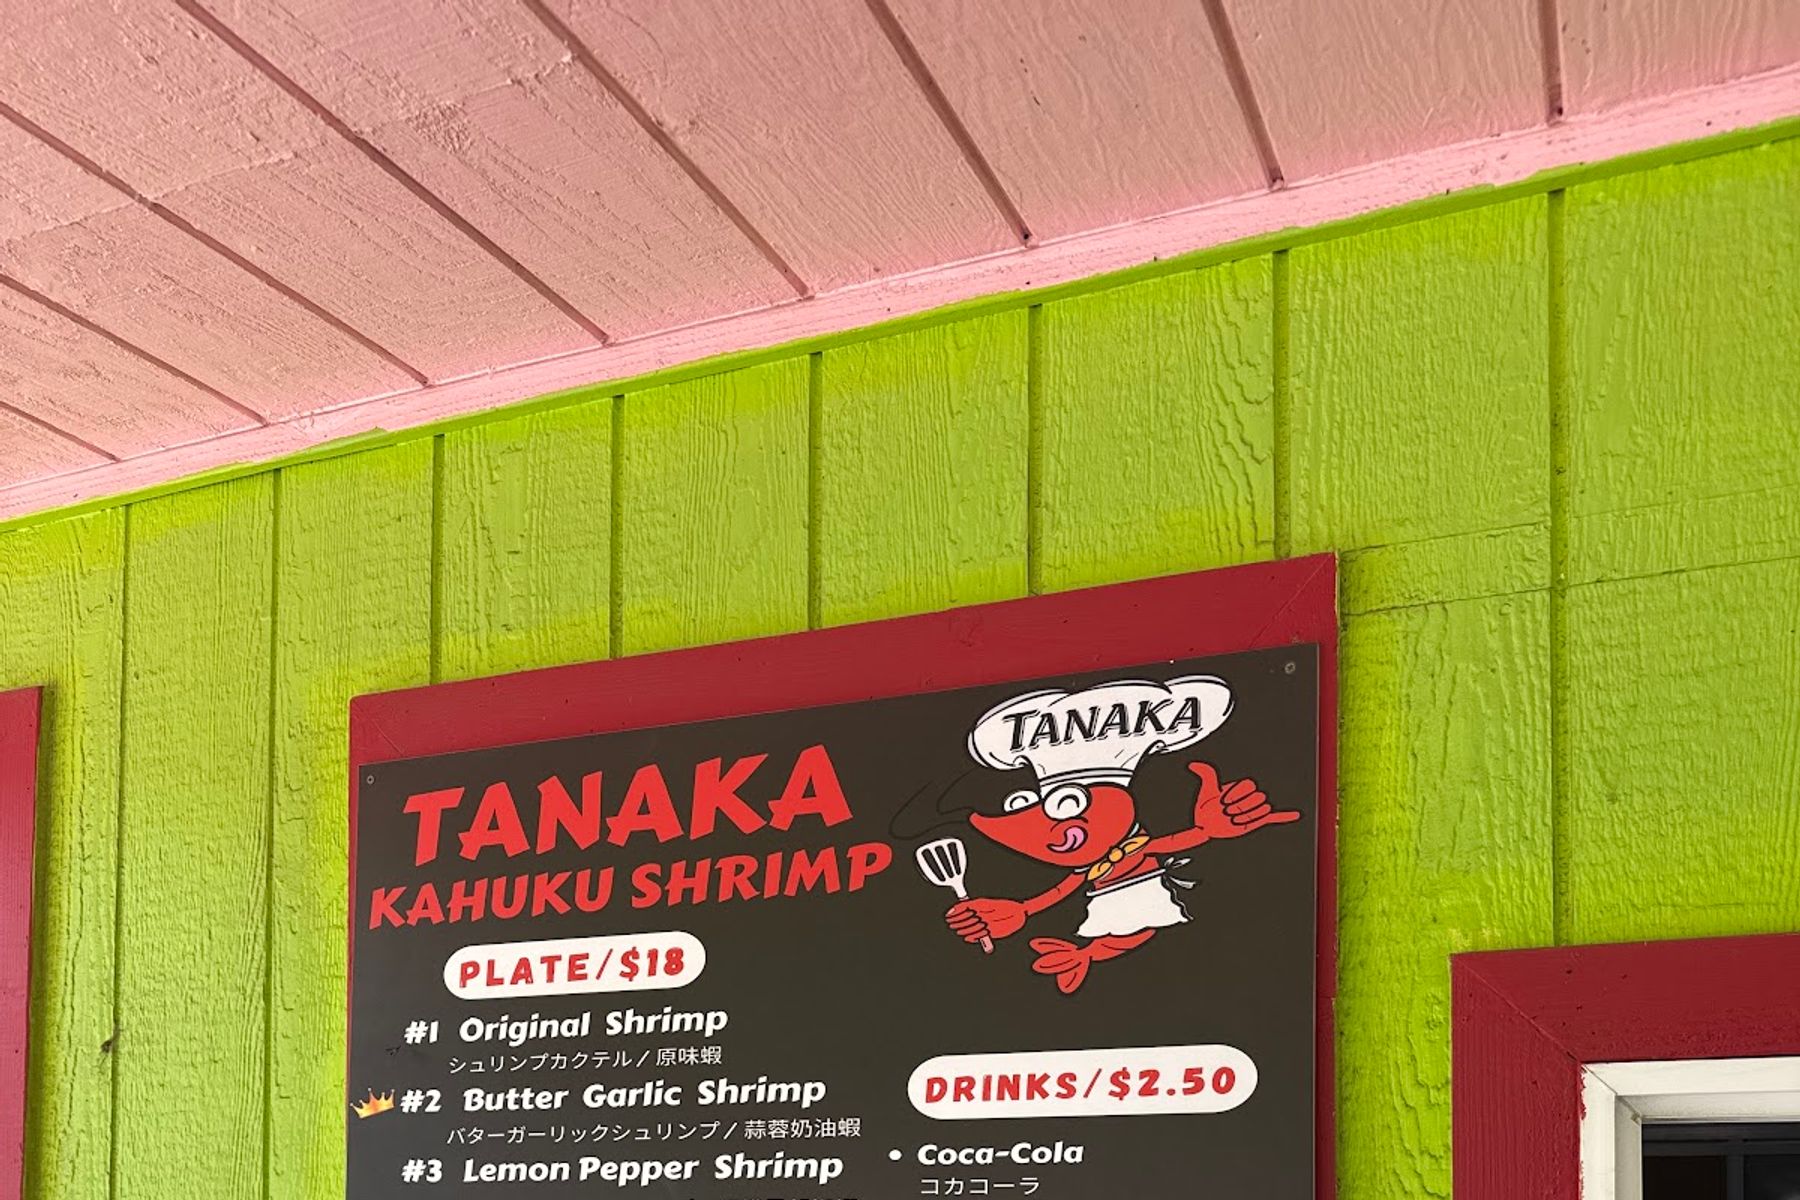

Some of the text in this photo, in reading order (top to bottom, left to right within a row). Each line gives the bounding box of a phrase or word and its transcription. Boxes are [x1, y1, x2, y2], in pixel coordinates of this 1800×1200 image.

[1003, 697, 1203, 753] TANAKA
[403, 744, 853, 867] TANAKA
[369, 842, 892, 930] KAHUKU SHRIMP
[459, 947, 685, 988] PLATE/$18
[404, 1007, 728, 1047] #1 Original Shrimp
[400, 1076, 827, 1113] #2 Butter Garlic Shrimp
[925, 1066, 1236, 1103] DRINKS/$2.50
[402, 1150, 844, 1187] #3 Lemon Pepper Shrimp
[917, 1142, 1085, 1166] Coca-Cola
[920, 1176, 1041, 1197] コカコーラ
